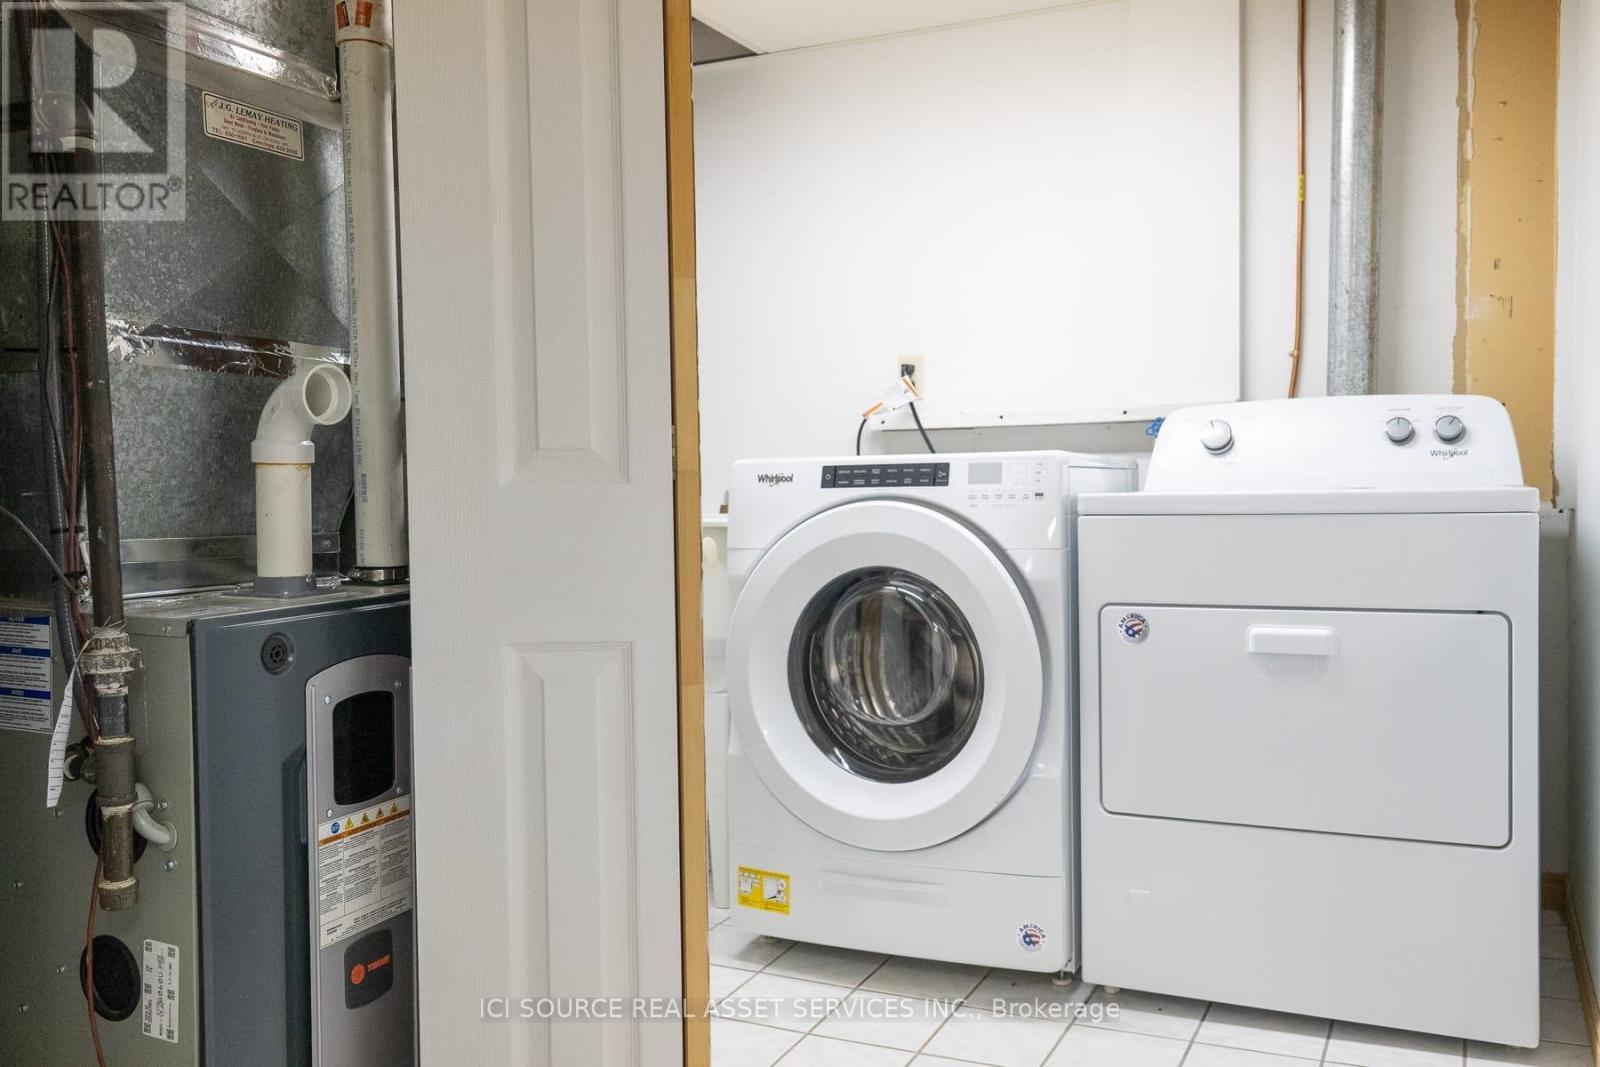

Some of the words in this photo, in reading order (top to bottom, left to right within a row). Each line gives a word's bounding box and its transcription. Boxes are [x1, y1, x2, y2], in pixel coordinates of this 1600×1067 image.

[236, 107, 263, 121] LEMAY
[264, 115, 298, 132] HEATING
[1430, 448, 1468, 461] Whirlpool
[757, 472, 794, 487] Whirlpool
